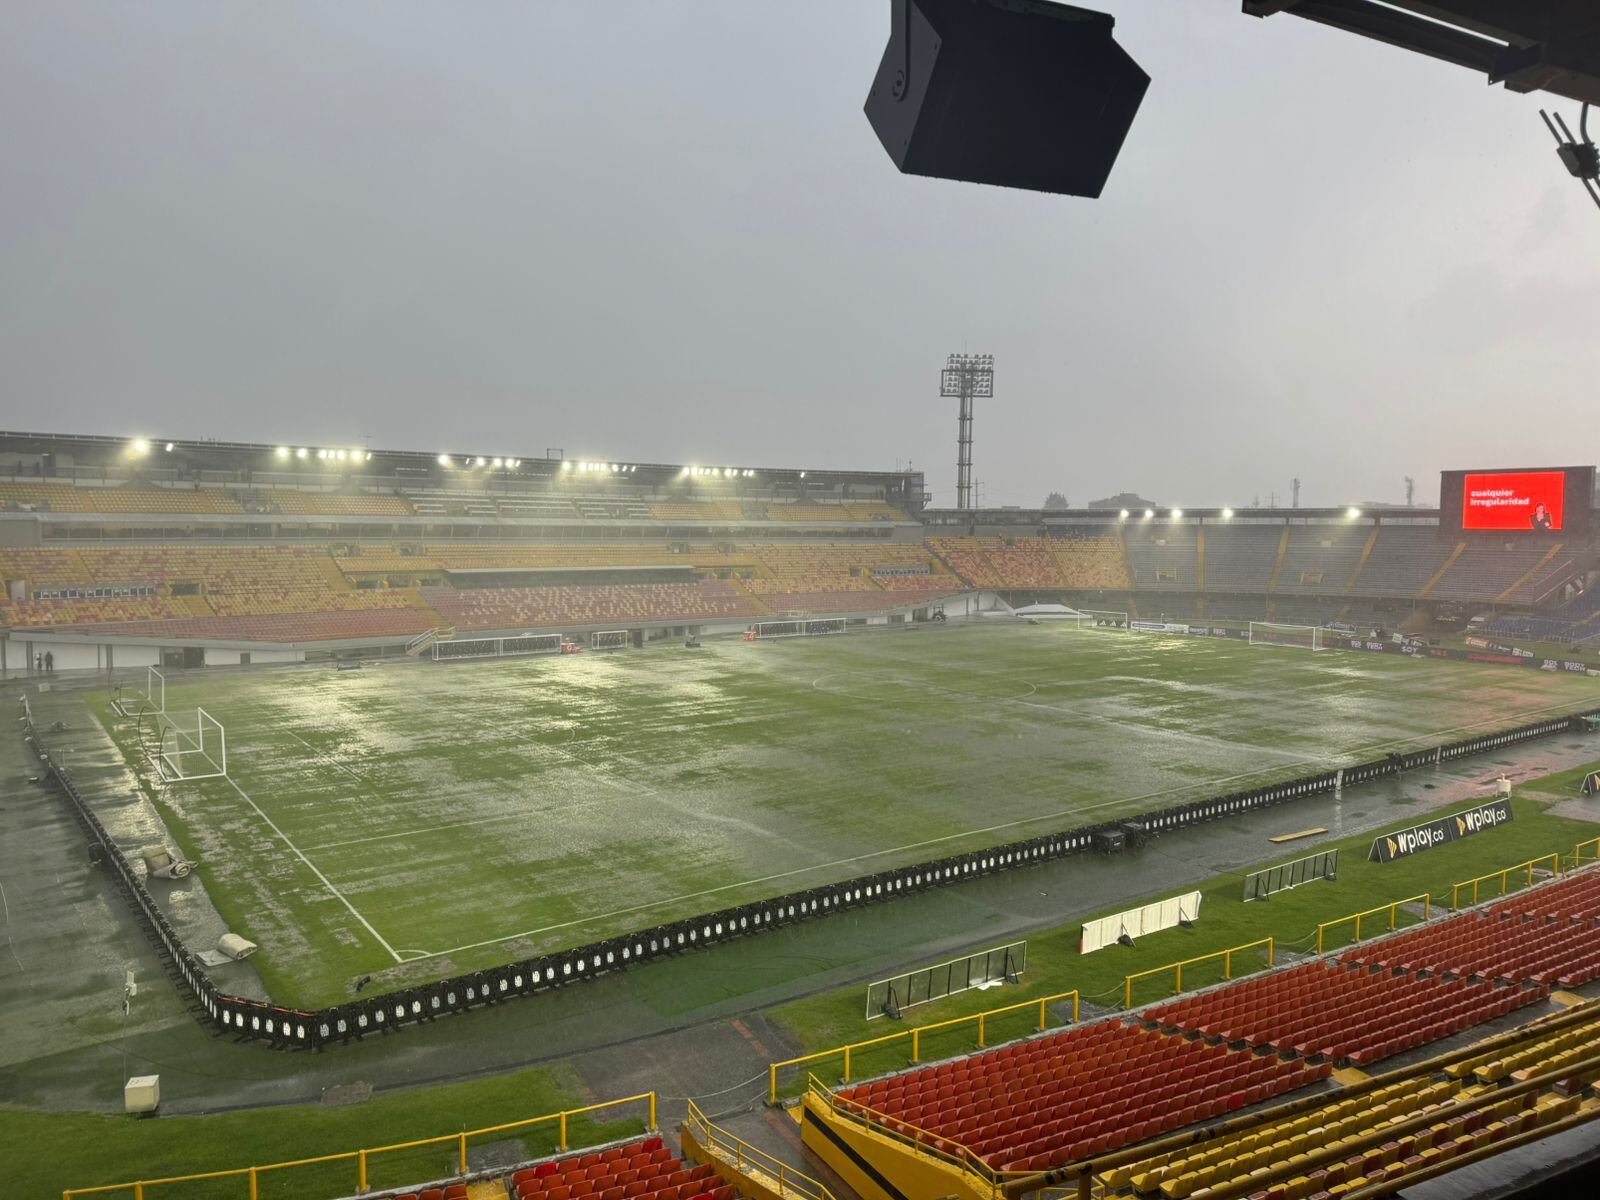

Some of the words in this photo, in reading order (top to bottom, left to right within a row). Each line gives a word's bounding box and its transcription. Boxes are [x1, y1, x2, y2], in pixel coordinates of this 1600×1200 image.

[1470, 489, 1514, 498] cualquier
[1470, 498, 1529, 507] irregularidad
[1465, 808, 1506, 831] Wplay.co
[1397, 828, 1444, 853] Wplay.co
